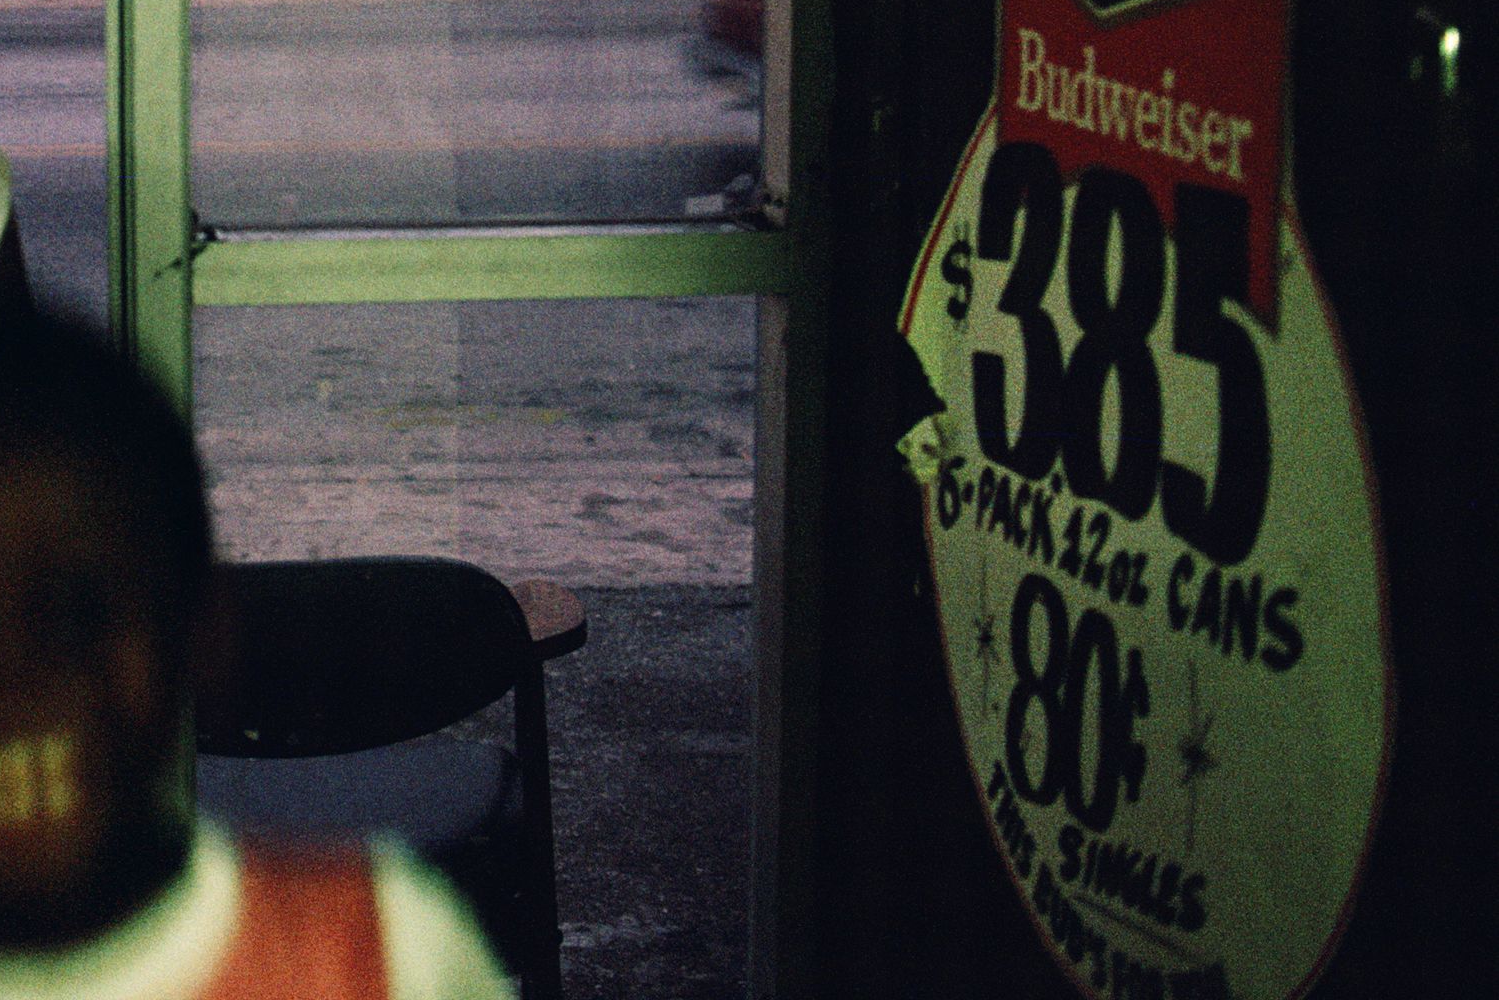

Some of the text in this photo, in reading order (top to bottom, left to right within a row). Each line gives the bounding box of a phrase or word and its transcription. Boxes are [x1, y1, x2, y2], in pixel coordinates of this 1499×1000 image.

[1015, 27, 1254, 181] Budweiser
[1167, 553, 1305, 672] CANS
[1057, 825, 1208, 931] SINGLES
